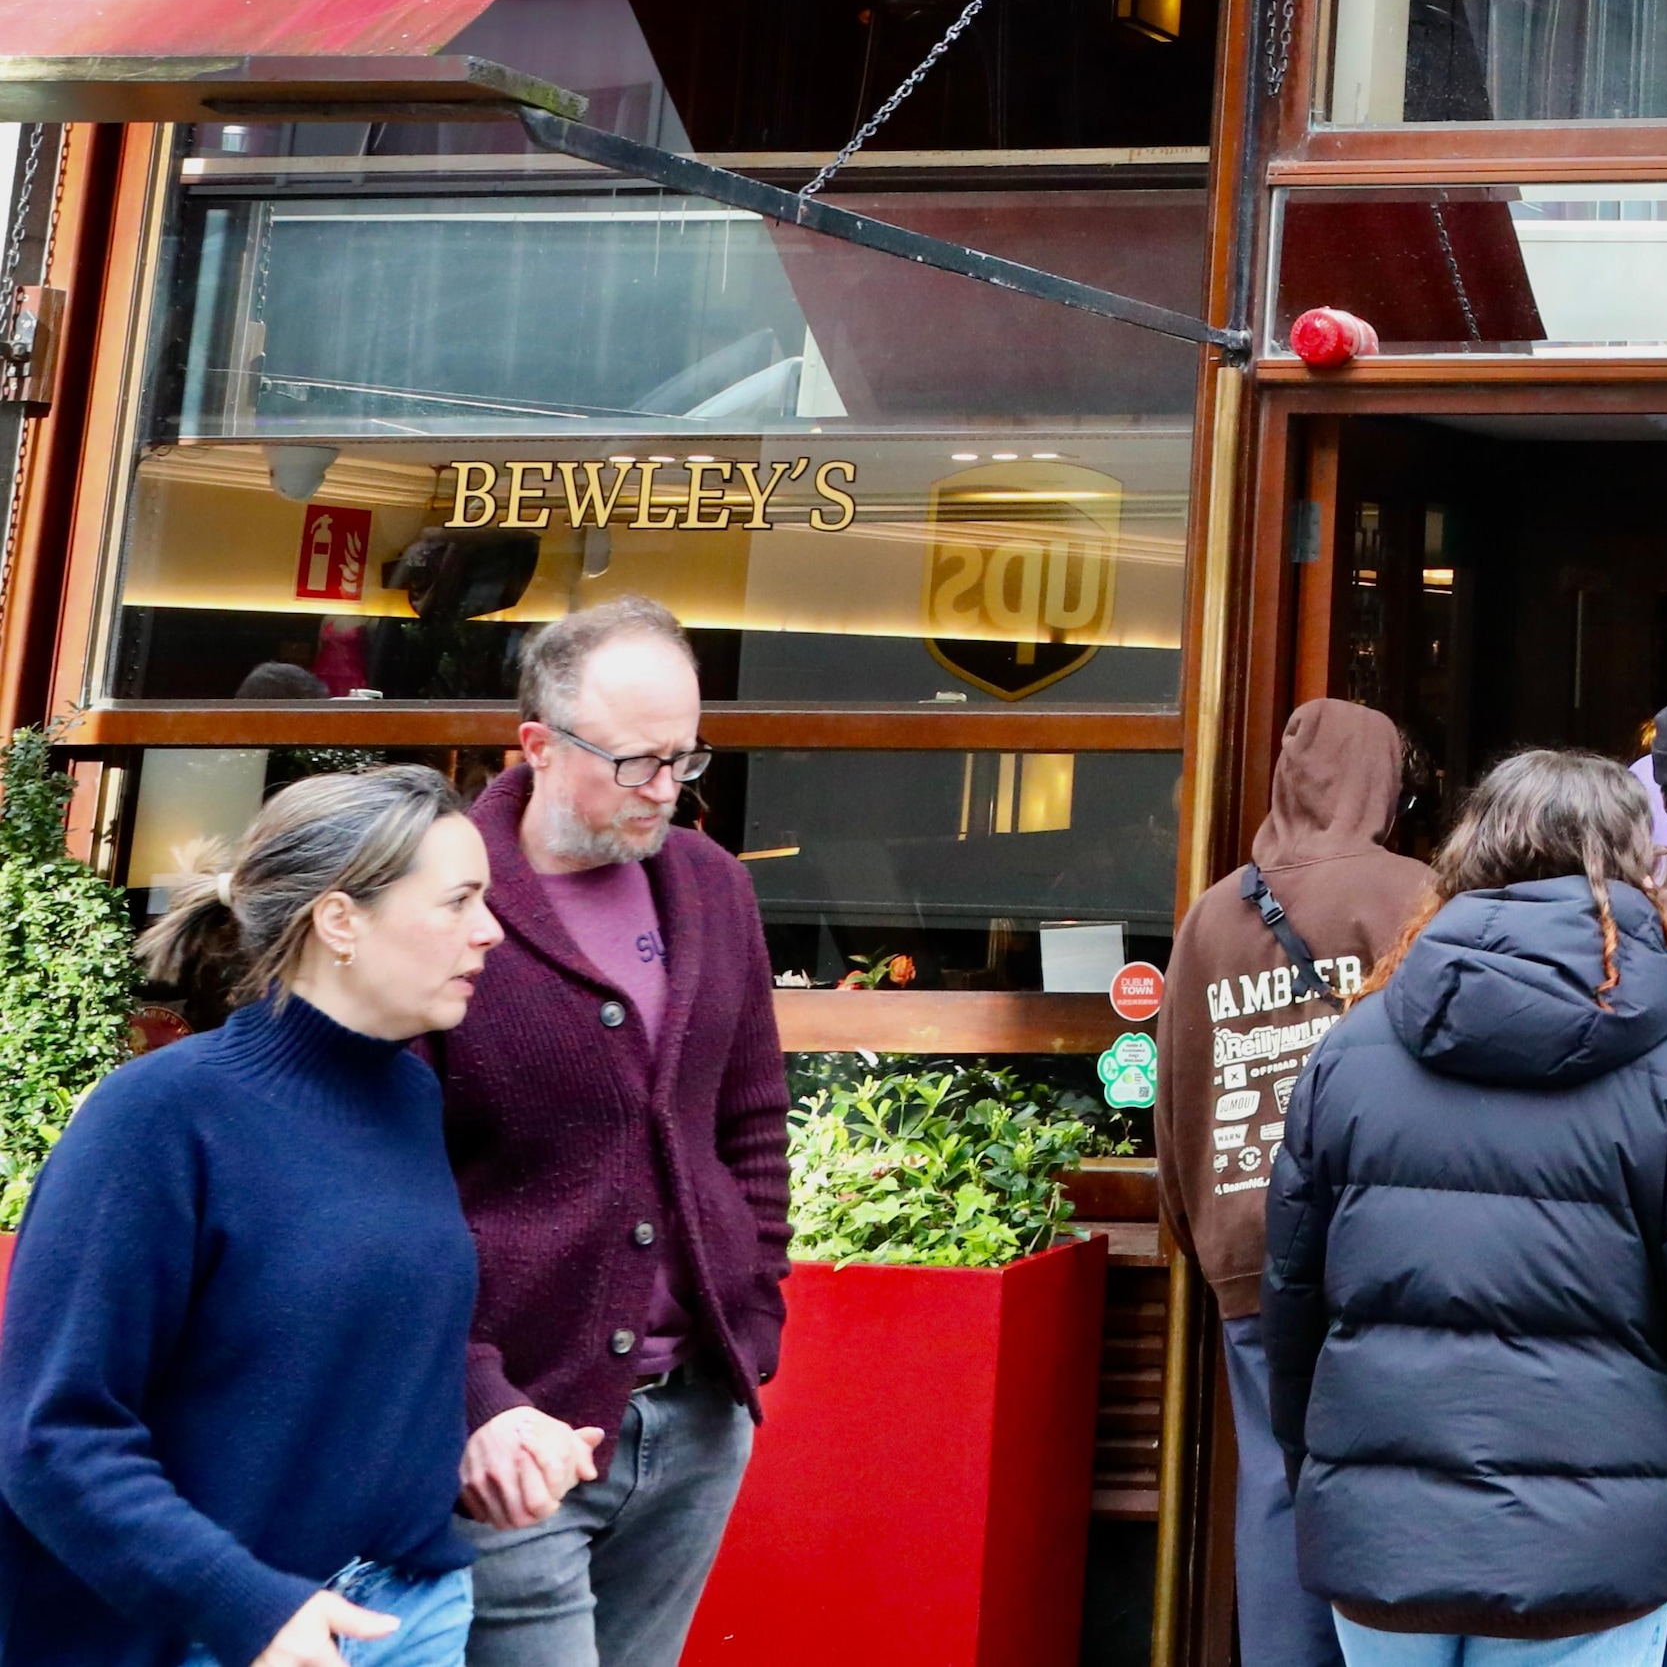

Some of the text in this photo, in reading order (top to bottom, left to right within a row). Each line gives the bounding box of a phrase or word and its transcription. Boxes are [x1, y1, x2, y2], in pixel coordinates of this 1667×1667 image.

[443, 456, 857, 531] BEWLEY’S
[1121, 978, 1154, 986] DUBLIN
[1121, 986, 1154, 995] TOWN
